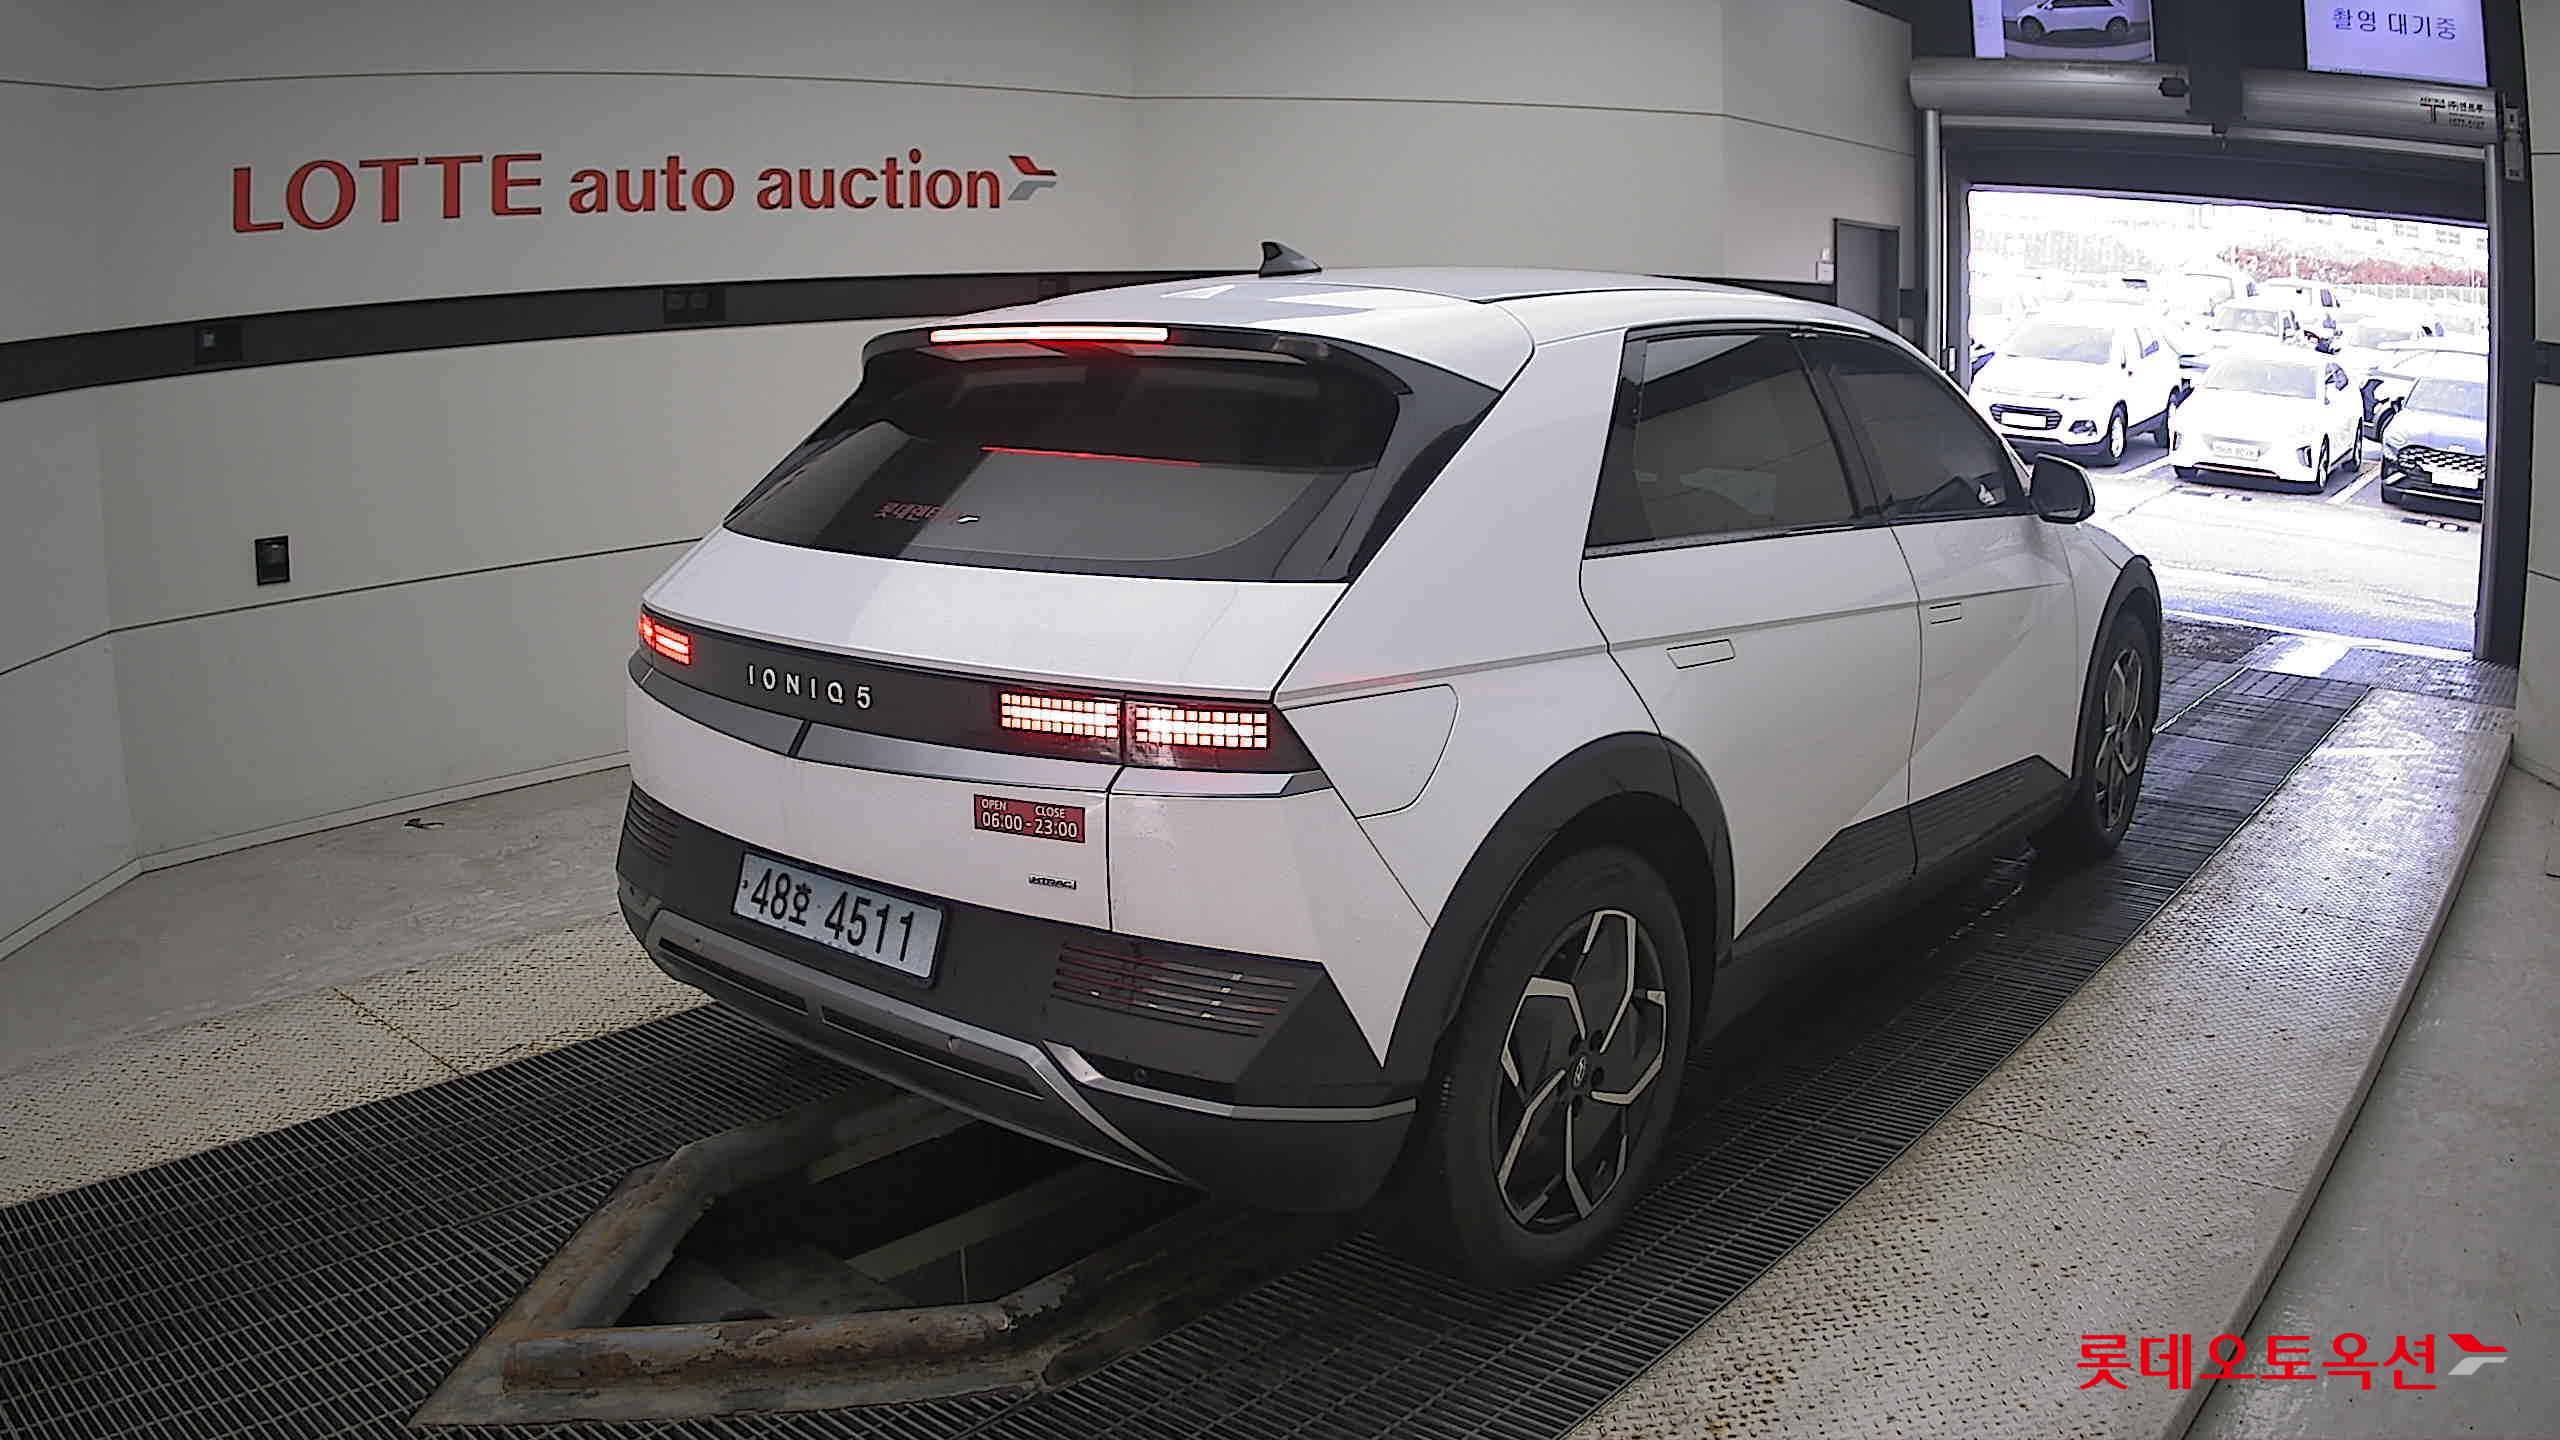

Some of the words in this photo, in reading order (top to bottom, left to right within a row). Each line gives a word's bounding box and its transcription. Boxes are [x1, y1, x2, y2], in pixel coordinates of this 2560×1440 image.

[2334, 7, 2376, 32] 촬영
[2388, 12, 2456, 40] 대기중
[233, 153, 542, 233] LOTTE
[569, 155, 735, 213] auto
[757, 148, 1000, 209] auction
[748, 664, 844, 704] IONIQ
[857, 685, 871, 709] 5
[981, 798, 1007, 811] OPEN
[1035, 805, 1065, 819] CLOSE
[982, 811, 1022, 831] 06:00
[1034, 818, 1077, 838] 23:00
[751, 868, 813, 927] 48호
[824, 890, 914, 962] 4511
